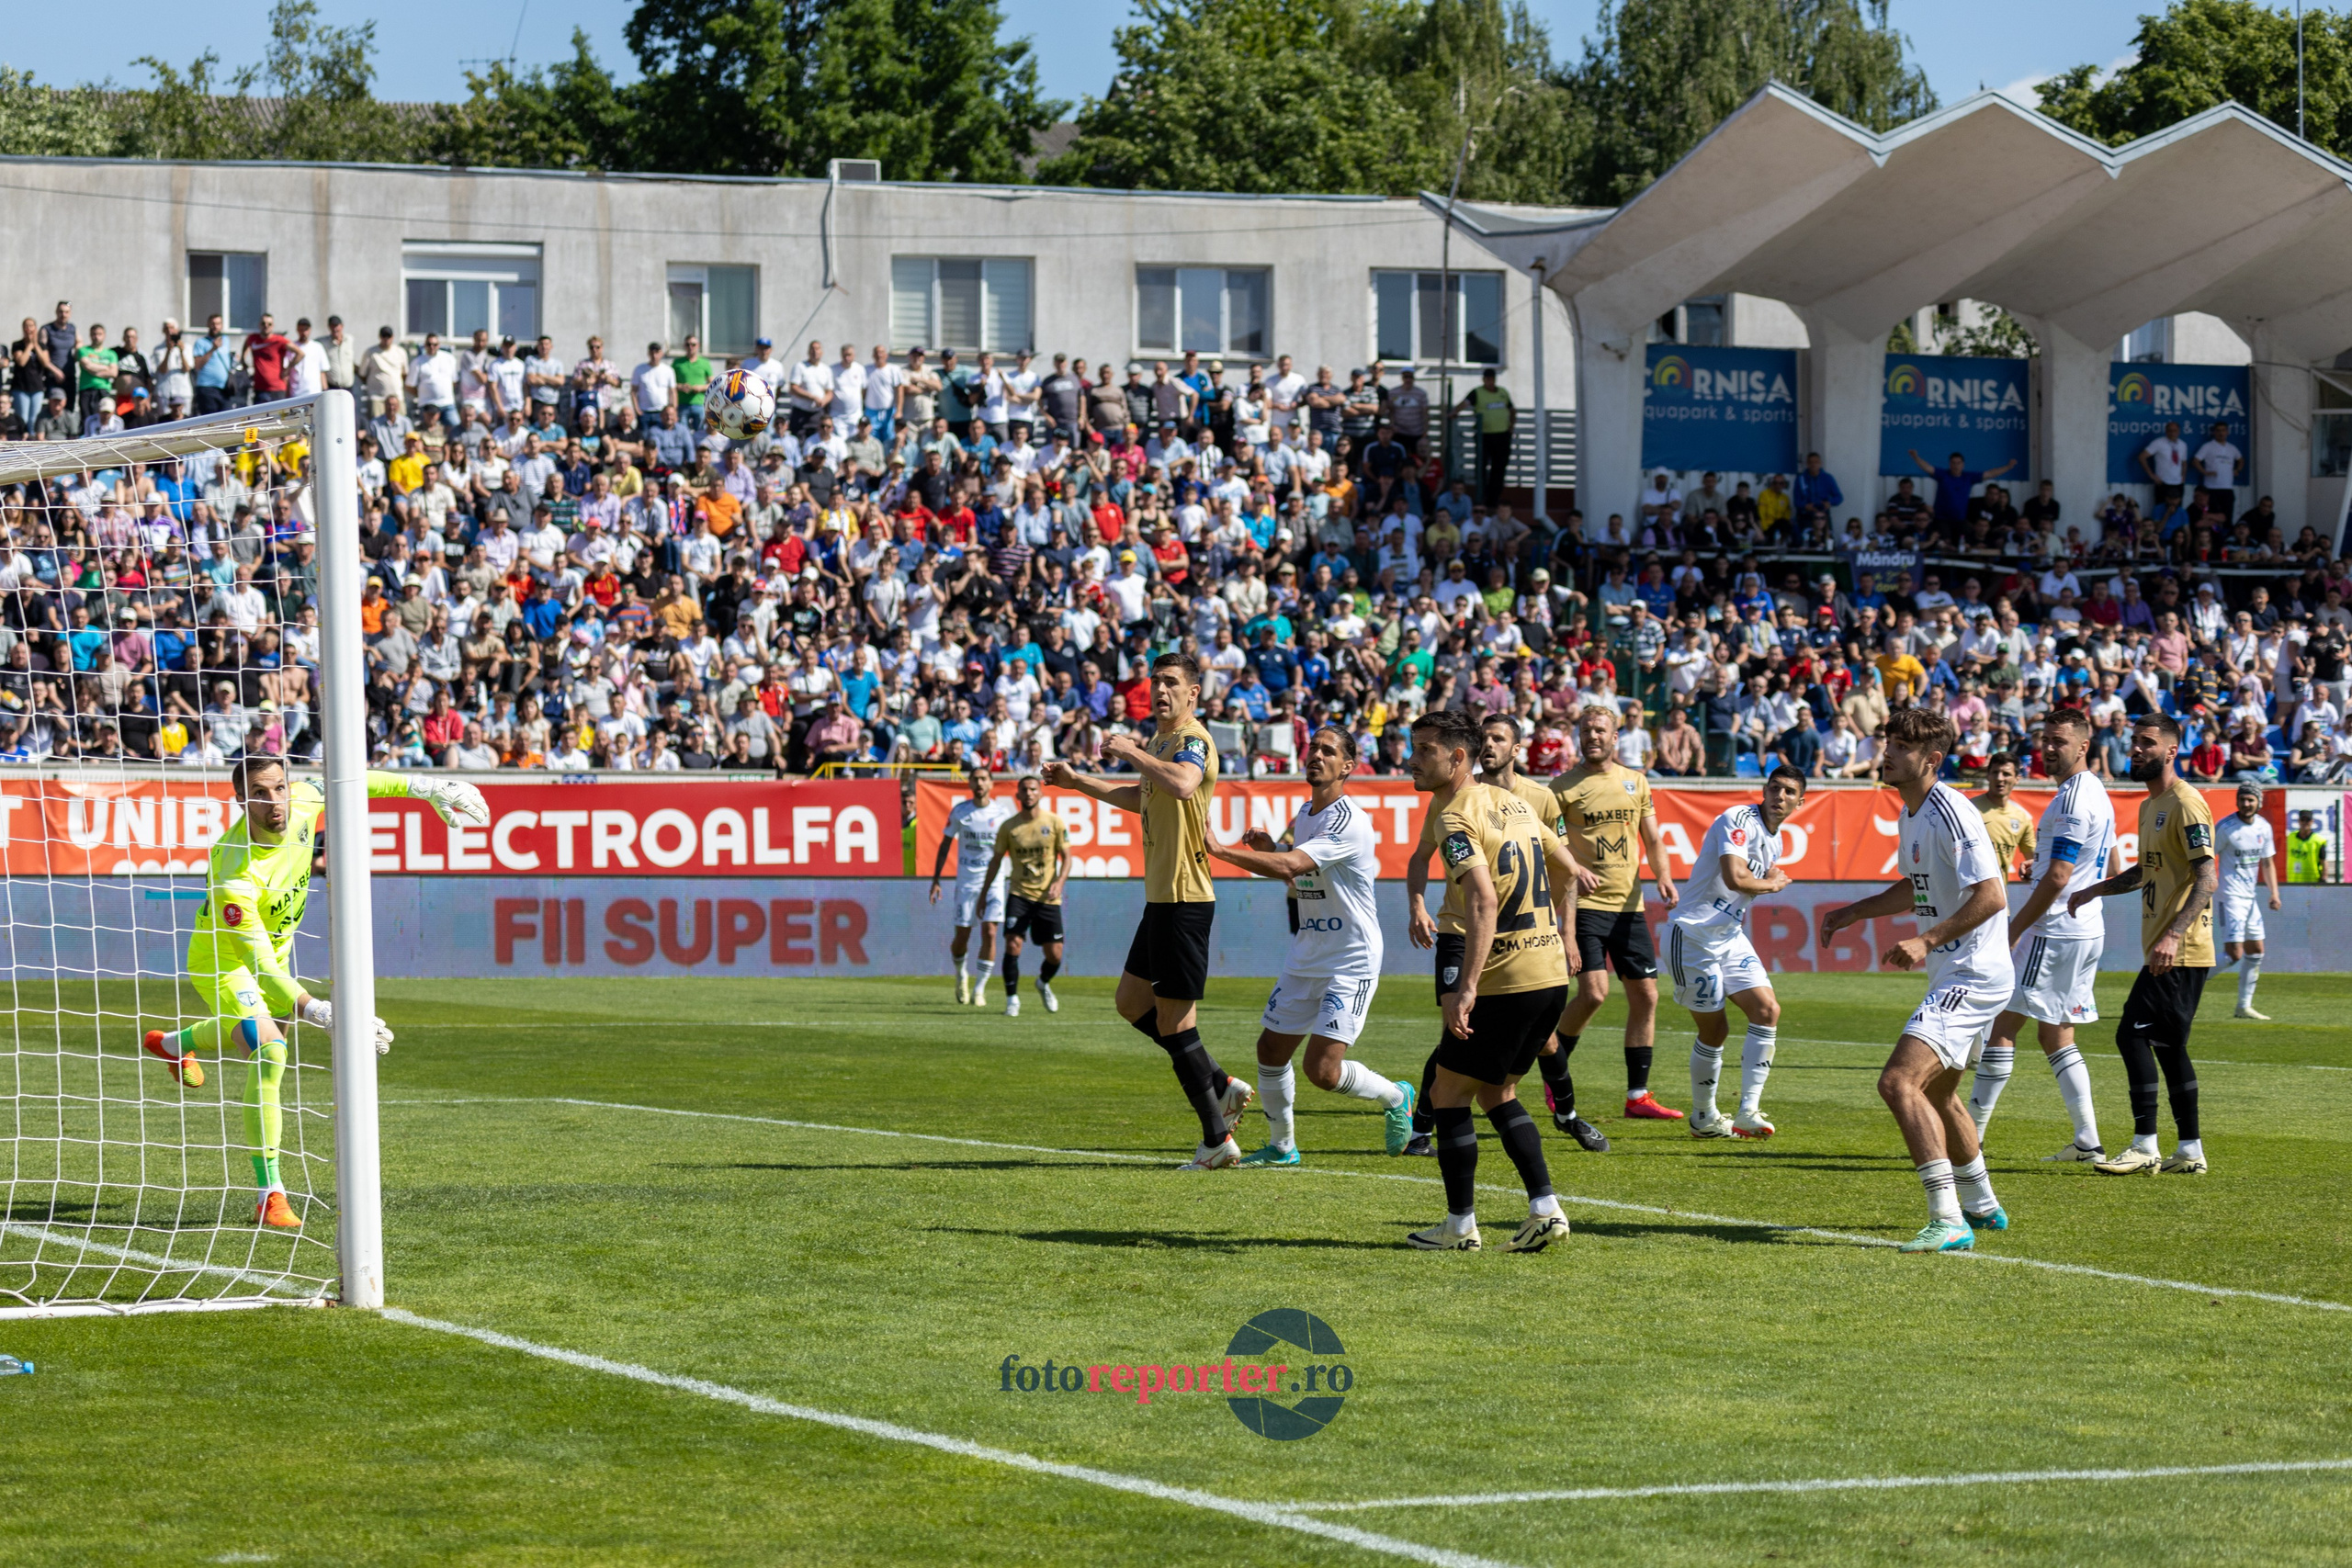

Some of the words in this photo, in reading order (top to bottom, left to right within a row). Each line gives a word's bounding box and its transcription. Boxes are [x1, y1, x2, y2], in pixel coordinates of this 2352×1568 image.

[1724, 406, 1736, 421] &
[1744, 408, 1794, 423] sports
[1958, 414, 1970, 429] &
[1976, 417, 2027, 432] sports
[2183, 421, 2193, 434] &
[68, 795, 234, 851] UNIB
[1584, 809, 1634, 827] MAXBET
[369, 805, 879, 871] ELECTROALFA
[1497, 837, 1556, 933] 24
[494, 897, 584, 965] FII
[603, 897, 870, 966] SUPER
[1694, 974, 1718, 998] 27
